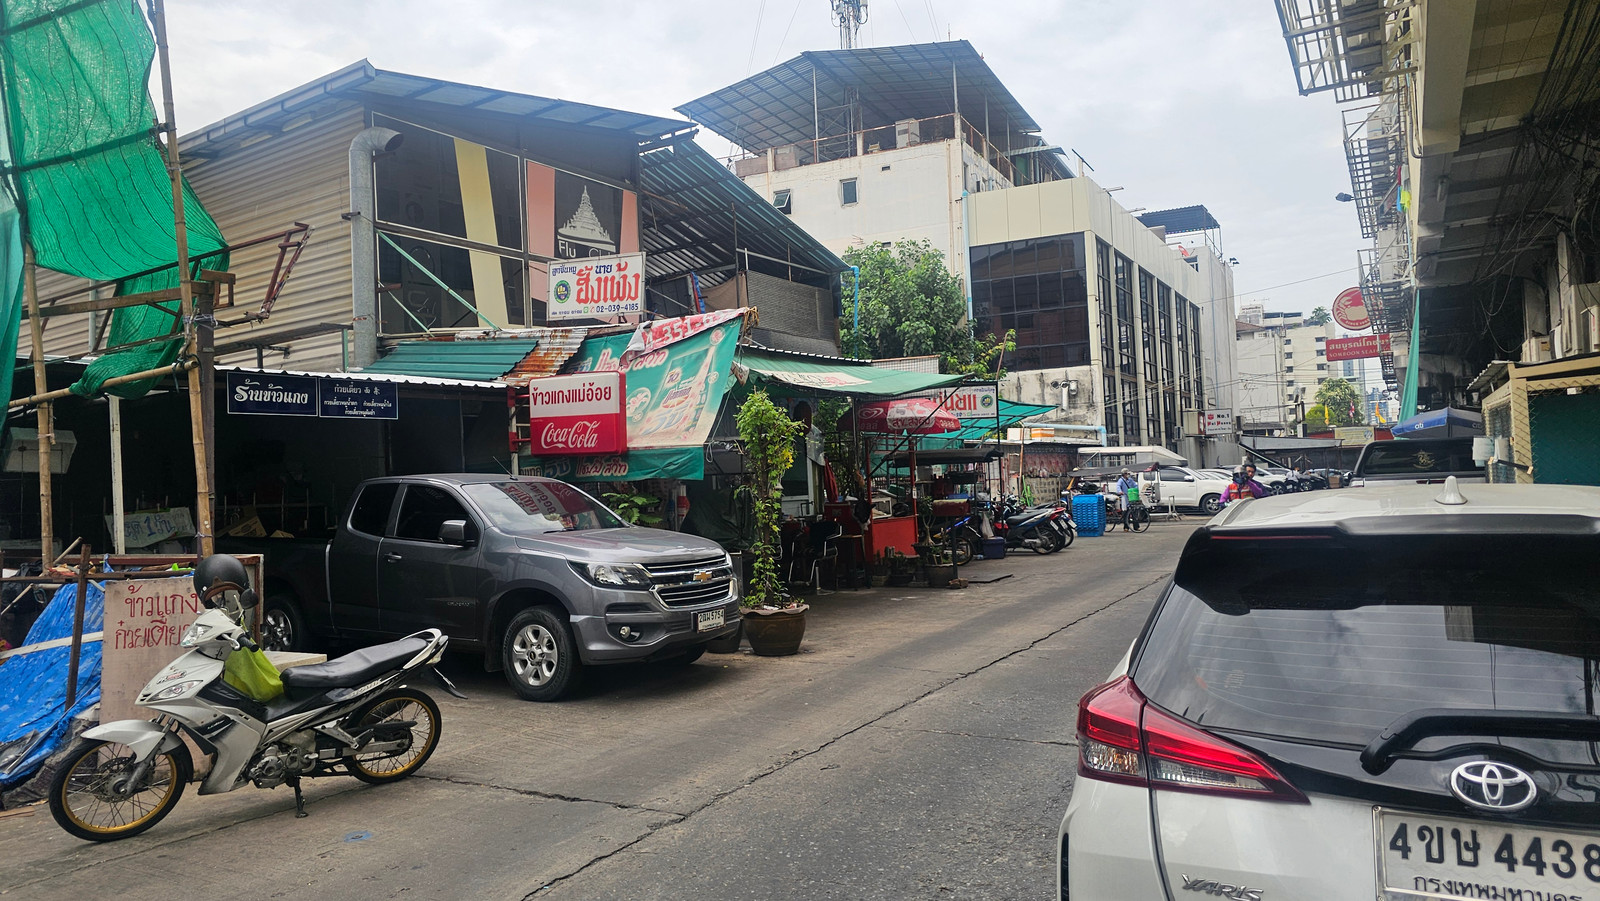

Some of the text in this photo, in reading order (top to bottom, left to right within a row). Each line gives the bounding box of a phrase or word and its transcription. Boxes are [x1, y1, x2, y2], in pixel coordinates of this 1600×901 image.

[595, 264, 613, 275] นาย
[596, 303, 639, 313] 02-039-4185
[234, 378, 309, 404] ร้านข้าวแกง
[531, 382, 612, 406] ข้าวแกงแม่อ้อย
[541, 420, 601, 449] Coca-Cola
[125, 584, 198, 618] ข้าวแกง
[1494, 833, 1600, 883] 4438
